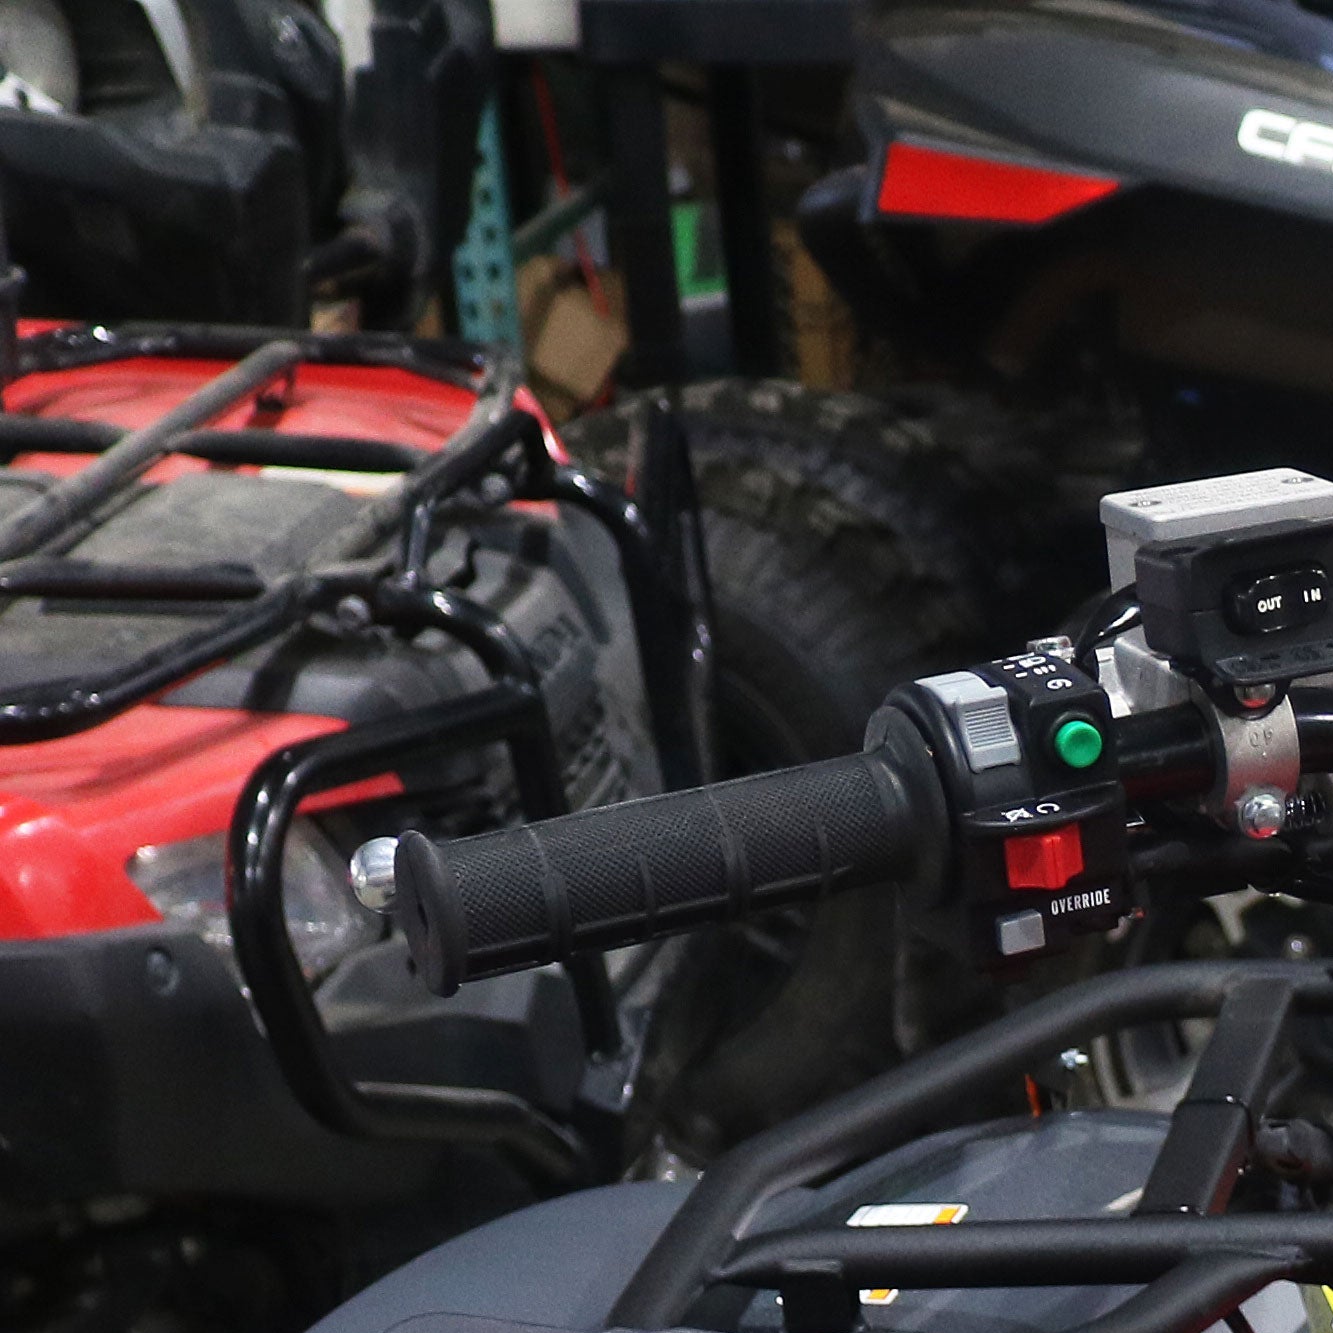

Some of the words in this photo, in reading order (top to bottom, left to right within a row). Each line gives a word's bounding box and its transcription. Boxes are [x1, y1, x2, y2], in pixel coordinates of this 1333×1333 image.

[1257, 596, 1282, 613] OUT
[1303, 588, 1322, 603] IN
[1051, 888, 1111, 915] OVERRIDE
